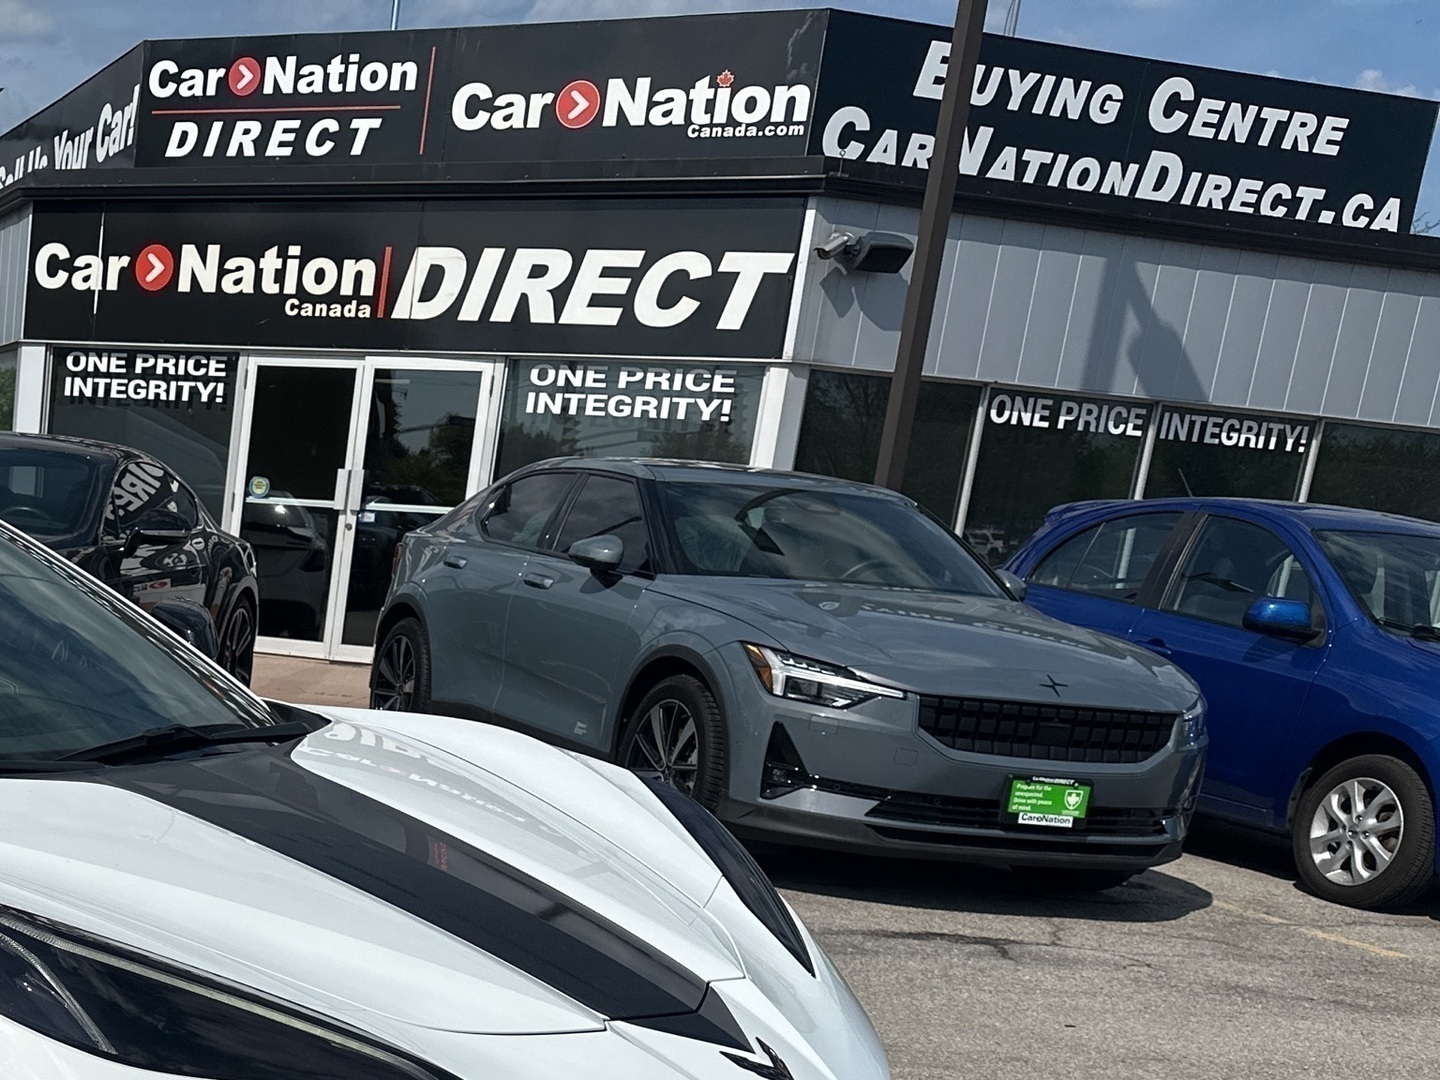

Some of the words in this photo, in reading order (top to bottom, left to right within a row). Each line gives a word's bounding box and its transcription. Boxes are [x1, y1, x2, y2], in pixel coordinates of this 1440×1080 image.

[149, 60, 226, 98] Car
[262, 54, 418, 95] Nation
[451, 82, 554, 131] Car
[602, 75, 811, 127] Nation
[1148, 77, 1350, 156] CENTRE
[54, 127, 94, 170] Your
[96, 84, 140, 163] Car!
[164, 118, 383, 157] DIRECT
[687, 123, 805, 138] Canada.com
[34, 242, 130, 291] Car
[177, 244, 376, 296] Nation
[390, 246, 795, 331] DIRECT
[285, 298, 371, 318] Canada
[66, 351, 128, 373] ONE
[135, 353, 228, 377] PRICE
[530, 364, 608, 388] ONE
[618, 366, 737, 393] PRICE
[64, 376, 225, 403] INTEGRITY!
[526, 392, 732, 421] INTEGRITY!
[990, 395, 1054, 428] ONE
[1057, 400, 1146, 437] PRICE
[1160, 412, 1309, 453] INTEGRITY!
[1040, 815, 1071, 825] Nation
